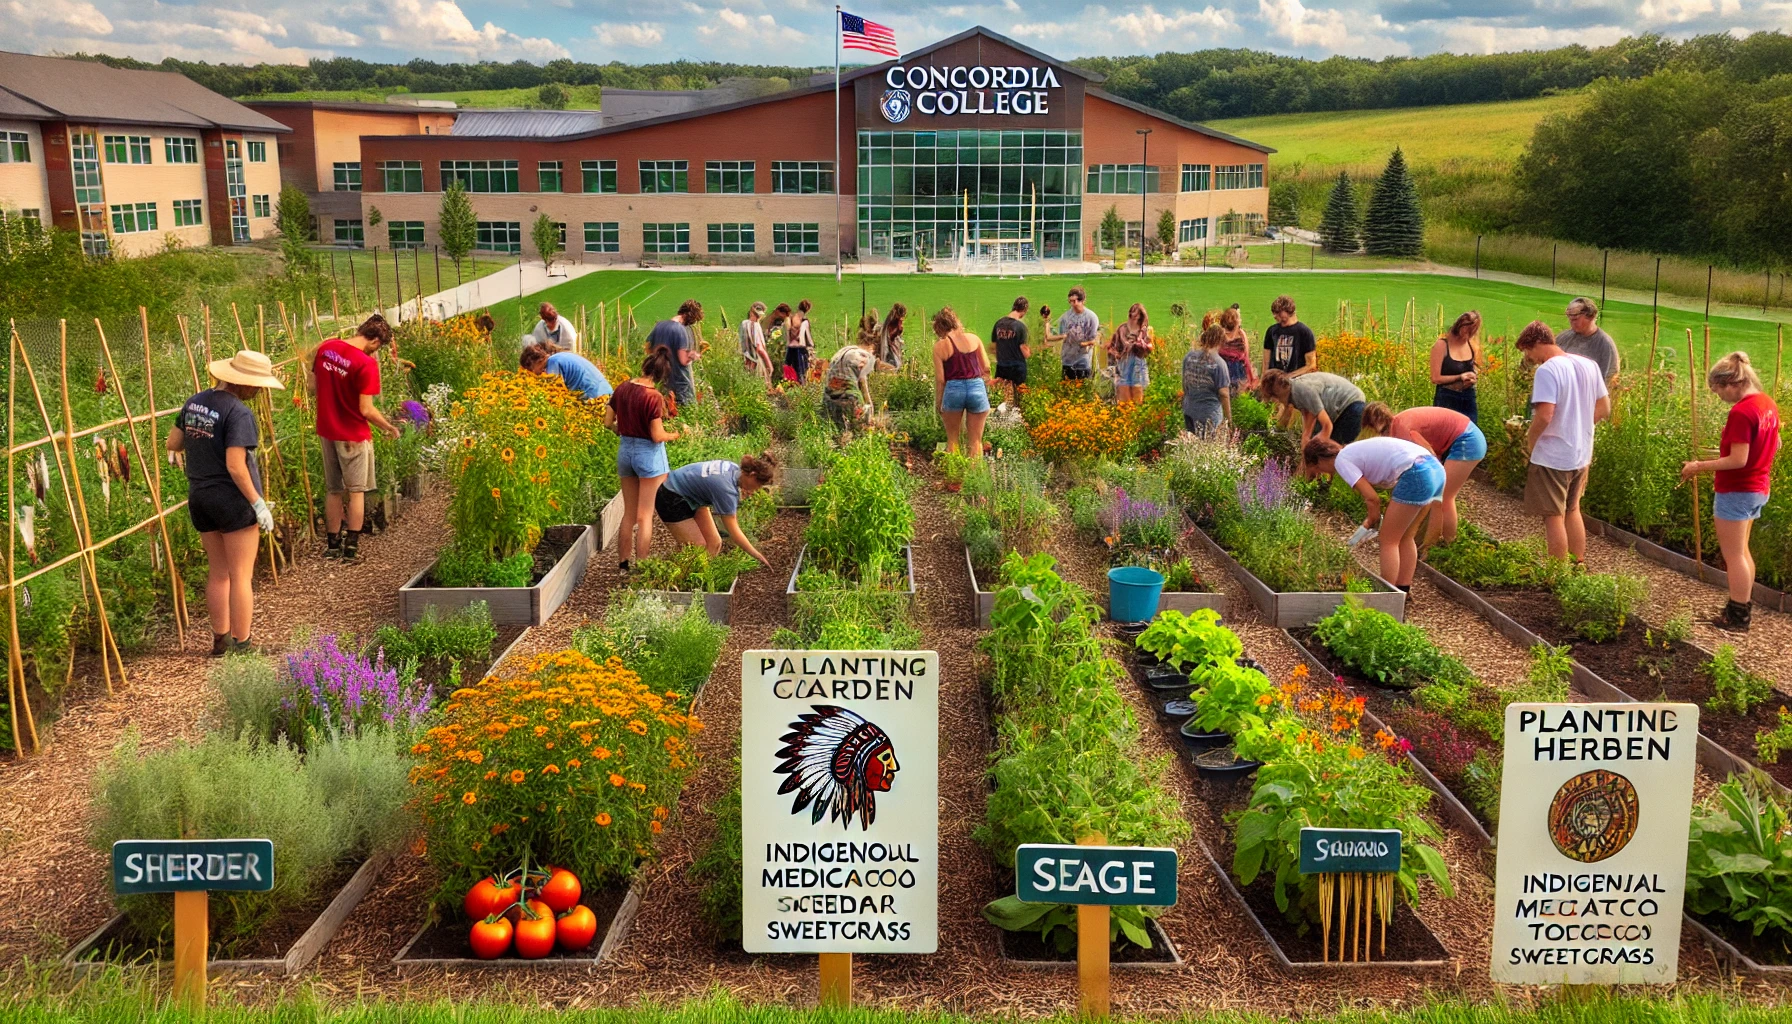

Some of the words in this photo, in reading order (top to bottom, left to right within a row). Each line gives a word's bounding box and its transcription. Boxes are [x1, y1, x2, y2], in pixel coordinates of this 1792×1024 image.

[886, 66, 1062, 89] CONCORDIA
[916, 91, 1049, 115] COLLEGE
[1534, 737, 1671, 761] HERBEN
[123, 852, 262, 884] SHERDER
[1032, 857, 1156, 894] SEAGE
